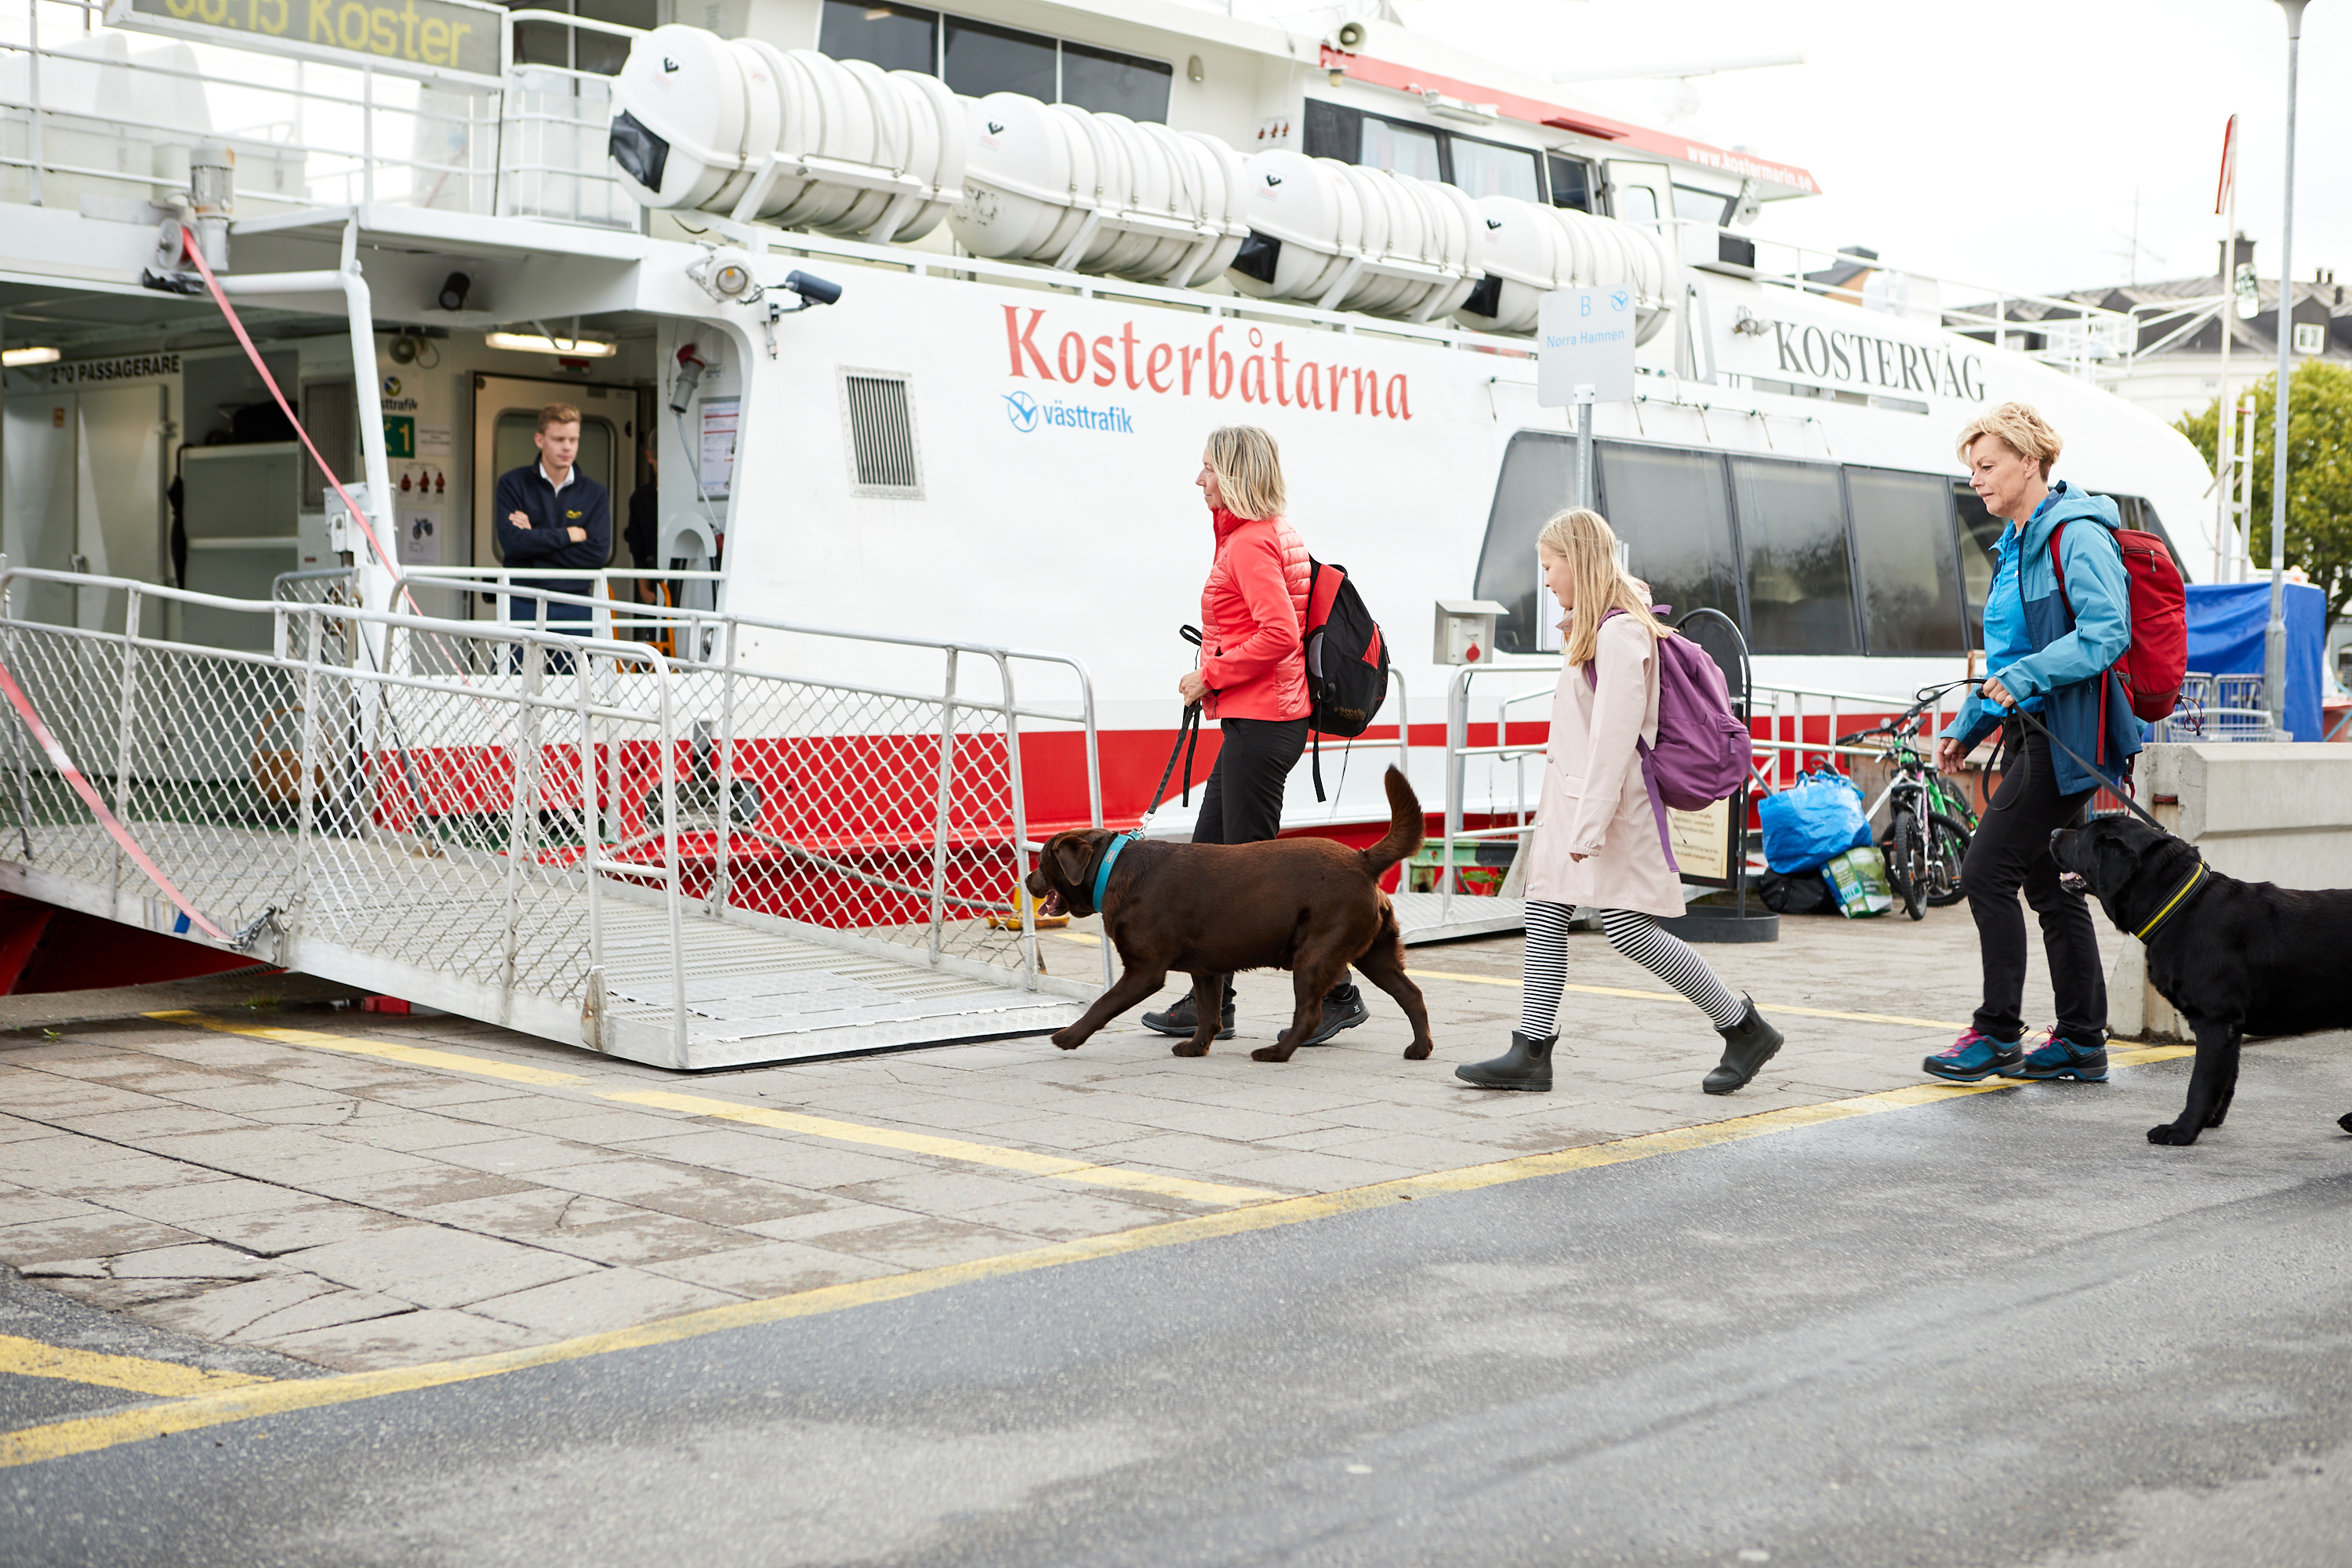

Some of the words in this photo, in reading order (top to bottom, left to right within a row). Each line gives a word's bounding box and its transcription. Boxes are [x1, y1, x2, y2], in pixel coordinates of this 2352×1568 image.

[309, 0, 471, 67] Koster
[1686, 146, 1813, 191] www.kostermarin.se
[1581, 295, 1592, 318] B
[1547, 335, 1577, 348] Norra
[1581, 329, 1624, 344] Hamnen
[79, 354, 180, 382] PASSAGERARE
[1000, 303, 1414, 421] Kosterbåtarna
[1773, 319, 1986, 402] KOSTERVÅG
[381, 397, 418, 412] sttrafik
[1042, 400, 1134, 434] västtrafik
[399, 423, 409, 453] 1
